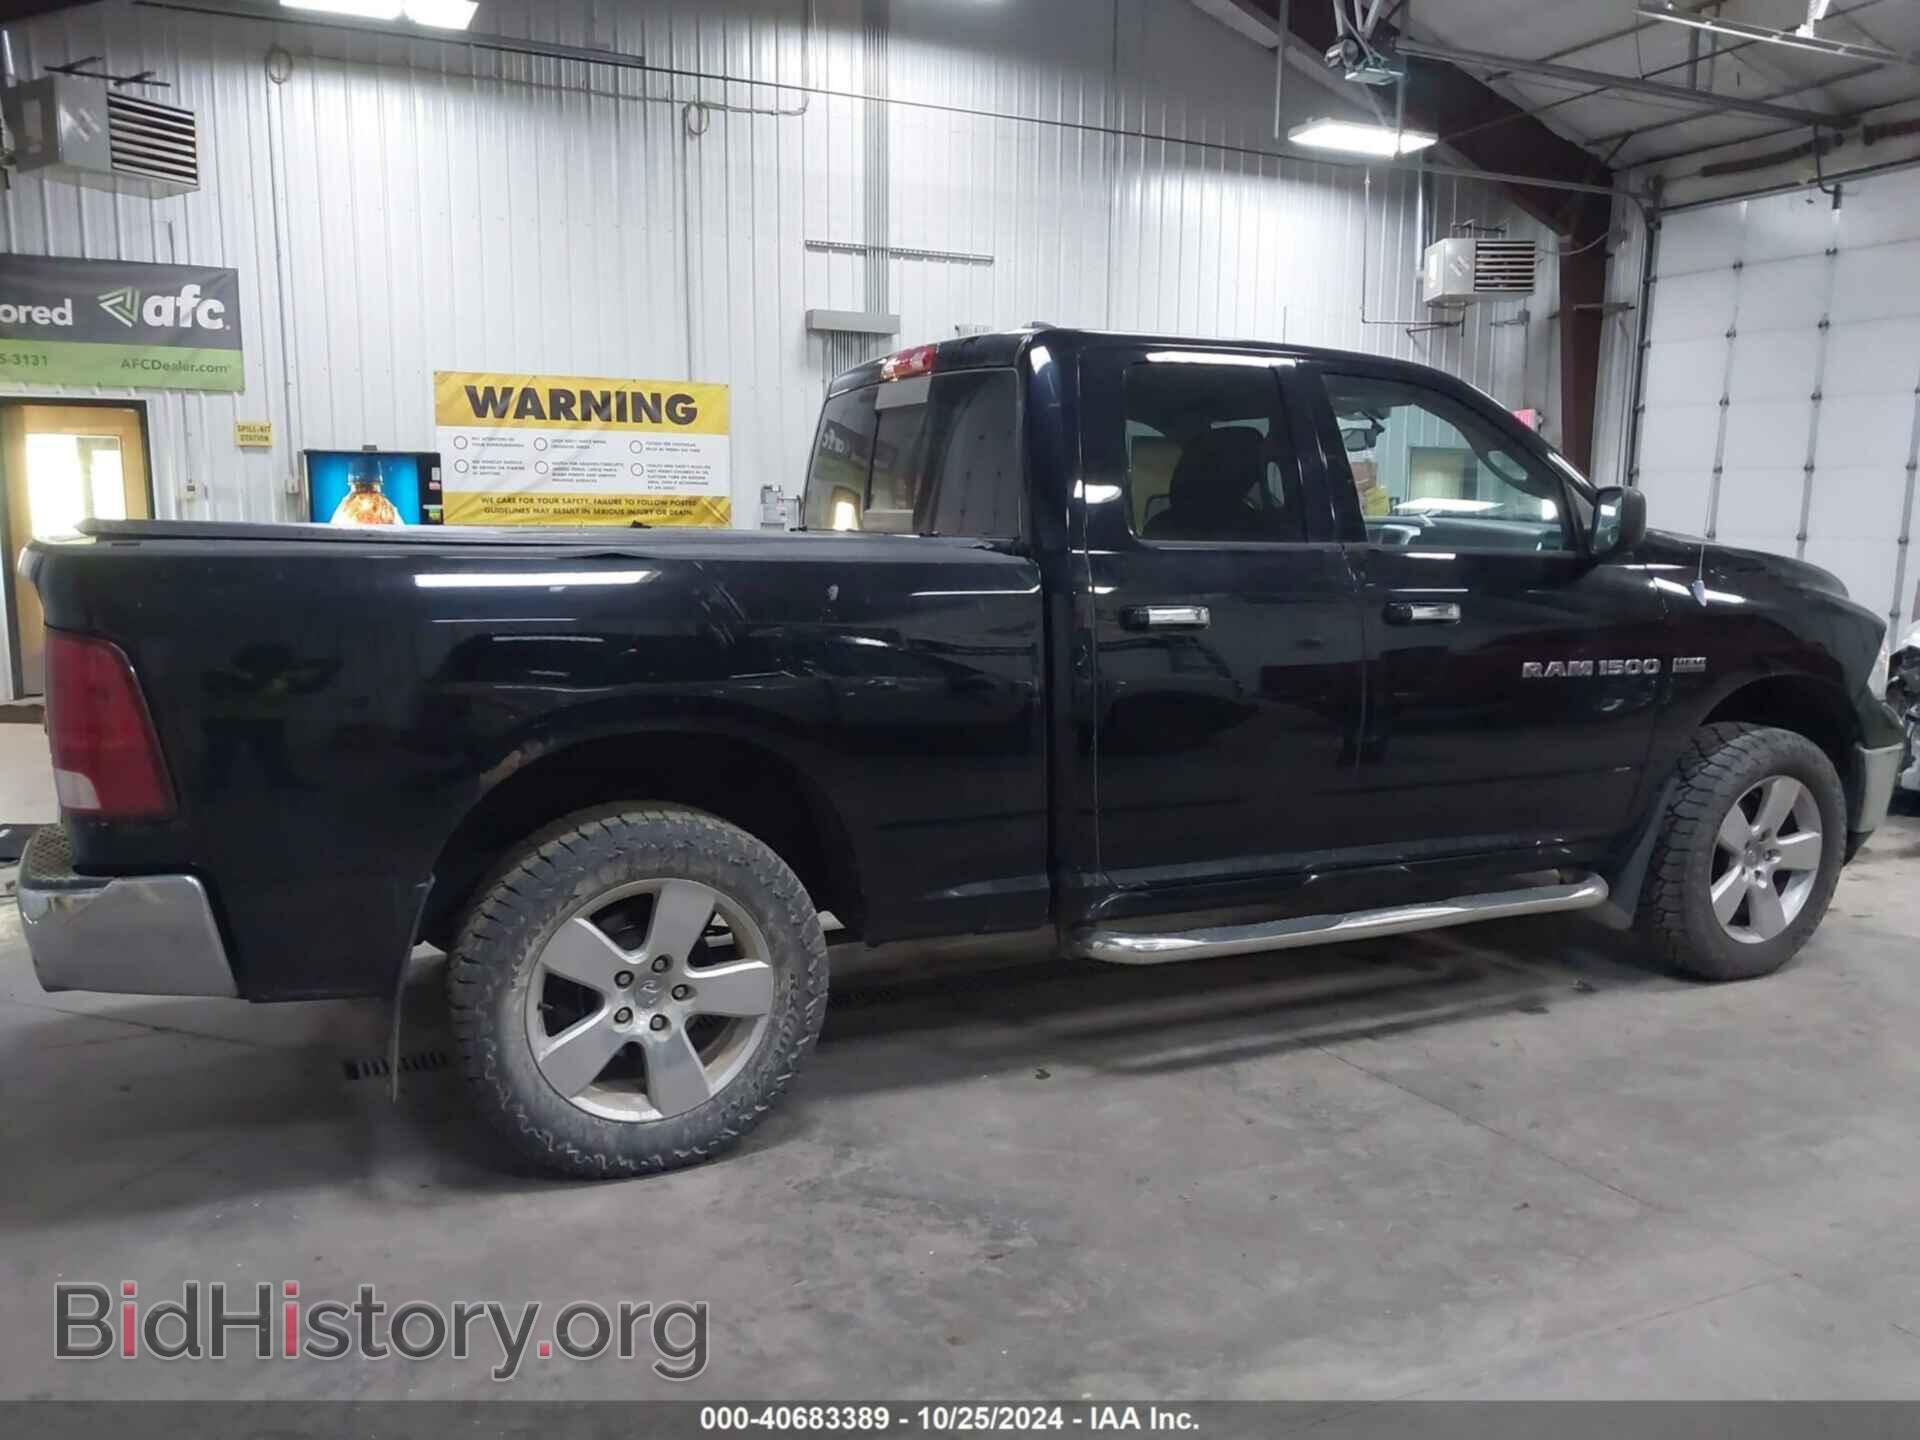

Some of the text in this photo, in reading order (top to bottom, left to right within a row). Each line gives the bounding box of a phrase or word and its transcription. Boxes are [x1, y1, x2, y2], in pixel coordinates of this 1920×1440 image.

[142, 284, 225, 330] afc
[121, 358, 228, 374] AFCDealer.com
[464, 385, 698, 425] WARNING
[1522, 661, 1594, 678] RAM
[1598, 658, 1661, 675] 1500
